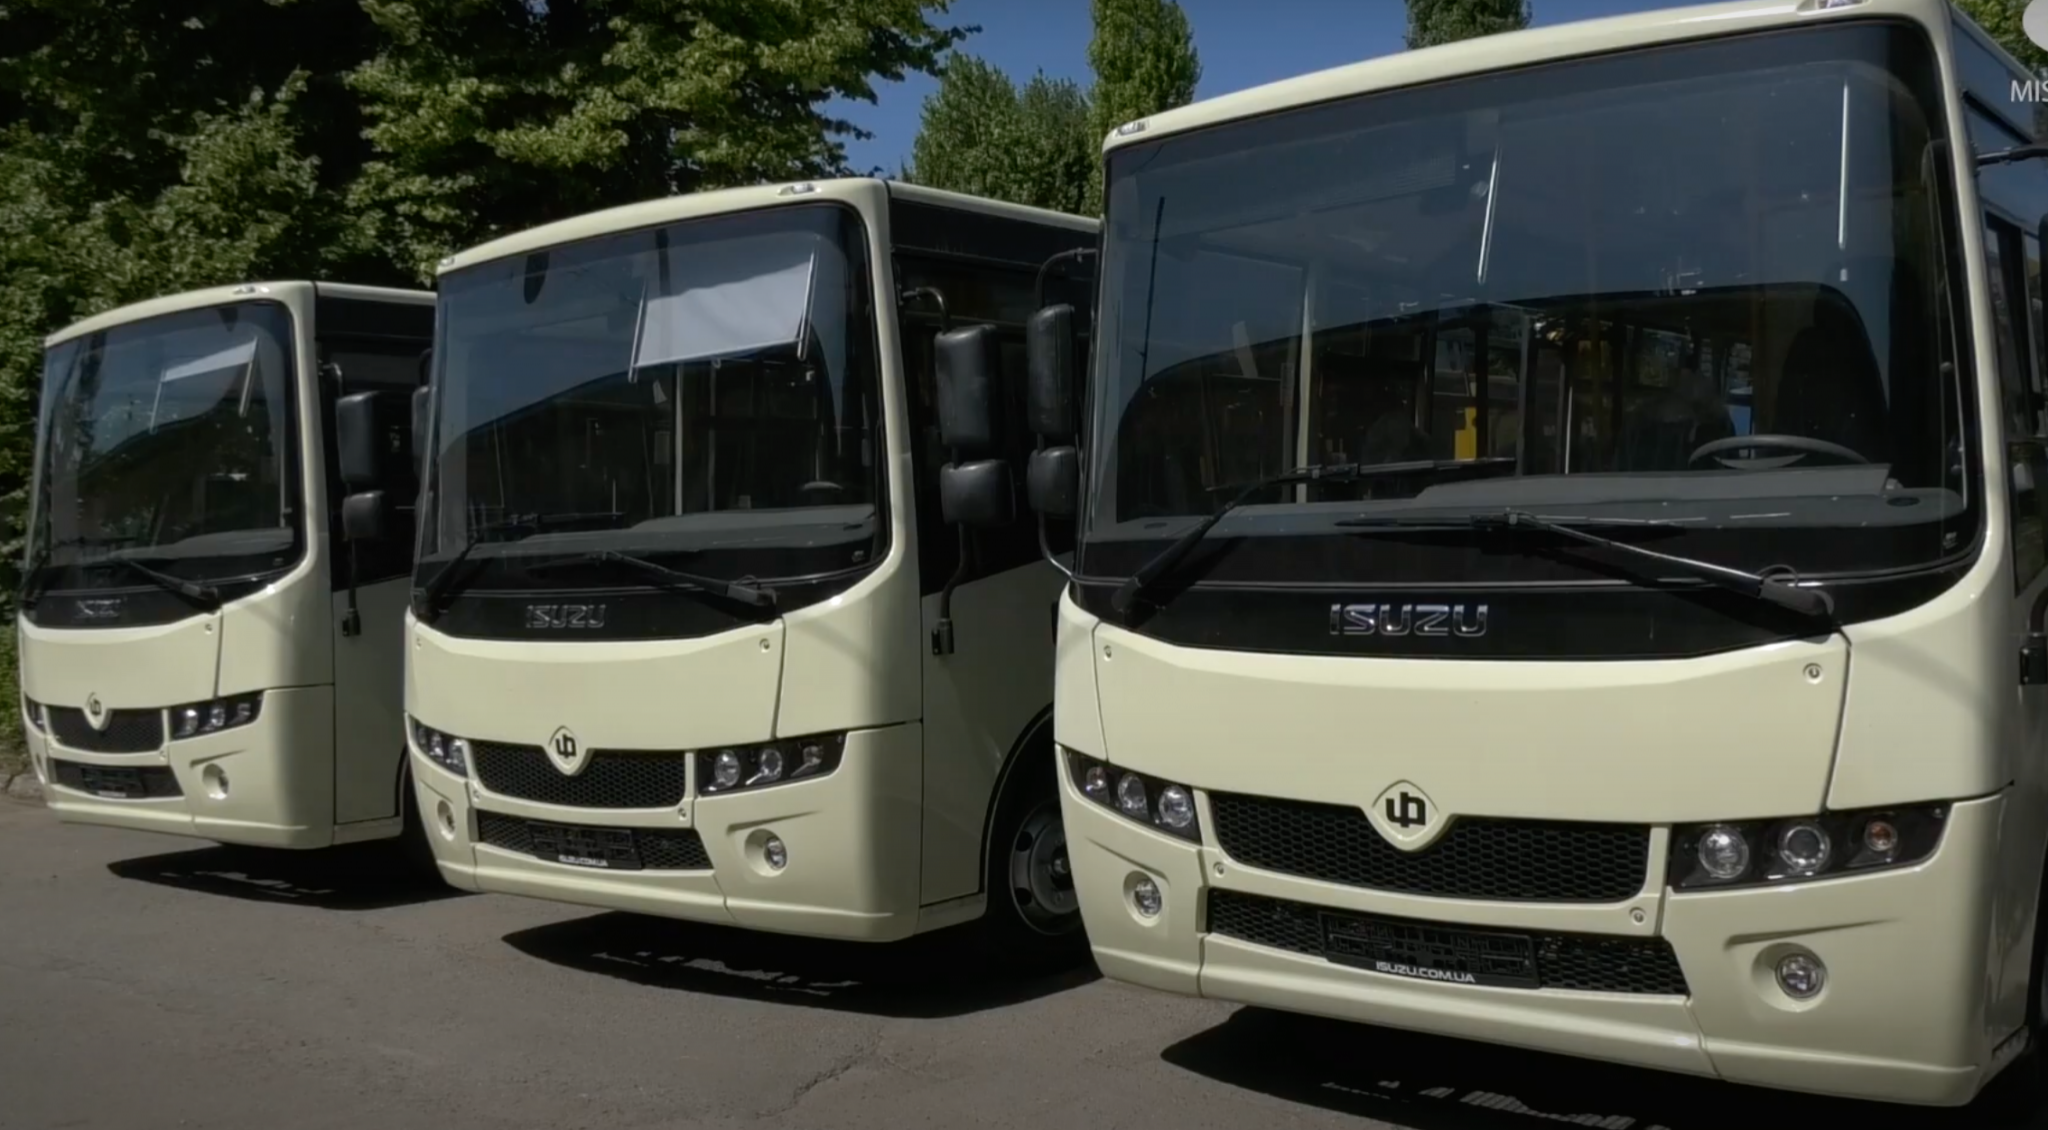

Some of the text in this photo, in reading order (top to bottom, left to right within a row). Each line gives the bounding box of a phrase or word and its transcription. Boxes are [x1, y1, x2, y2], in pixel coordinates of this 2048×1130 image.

[525, 604, 606, 628] ISUZU
[1329, 604, 1488, 637] ISUZU
[1375, 961, 1476, 983] ISUZU.COM.UA
